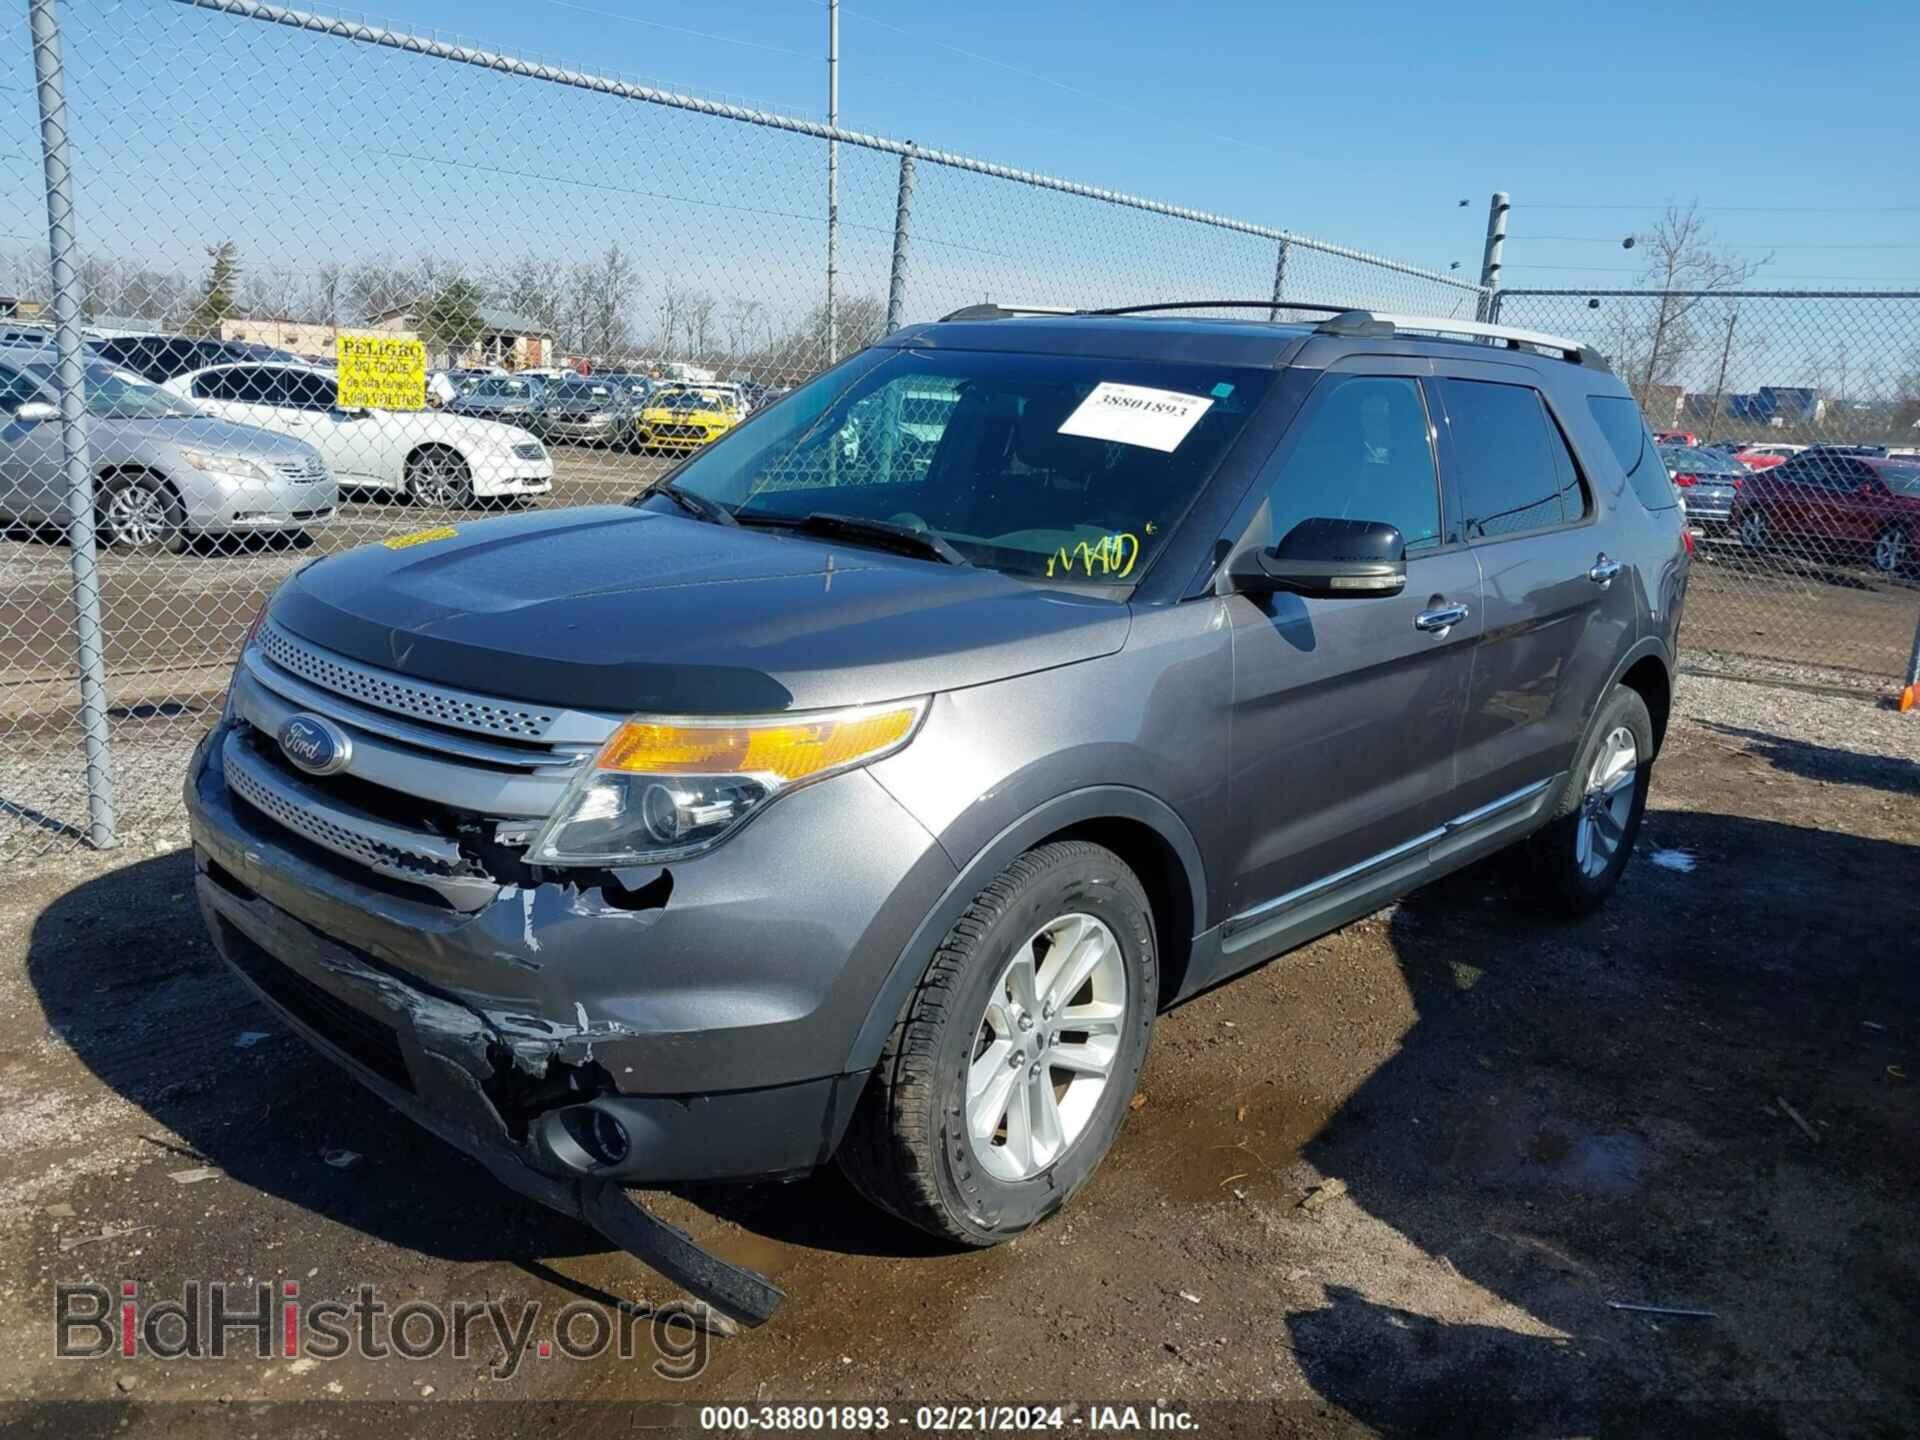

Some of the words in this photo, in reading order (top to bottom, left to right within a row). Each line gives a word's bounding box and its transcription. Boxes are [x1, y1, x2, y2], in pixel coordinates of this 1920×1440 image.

[343, 341, 422, 357] PELIGRO
[373, 360, 409, 374] TOQUE
[1096, 394, 1188, 417] 38801893
[284, 722, 321, 760] Ford
